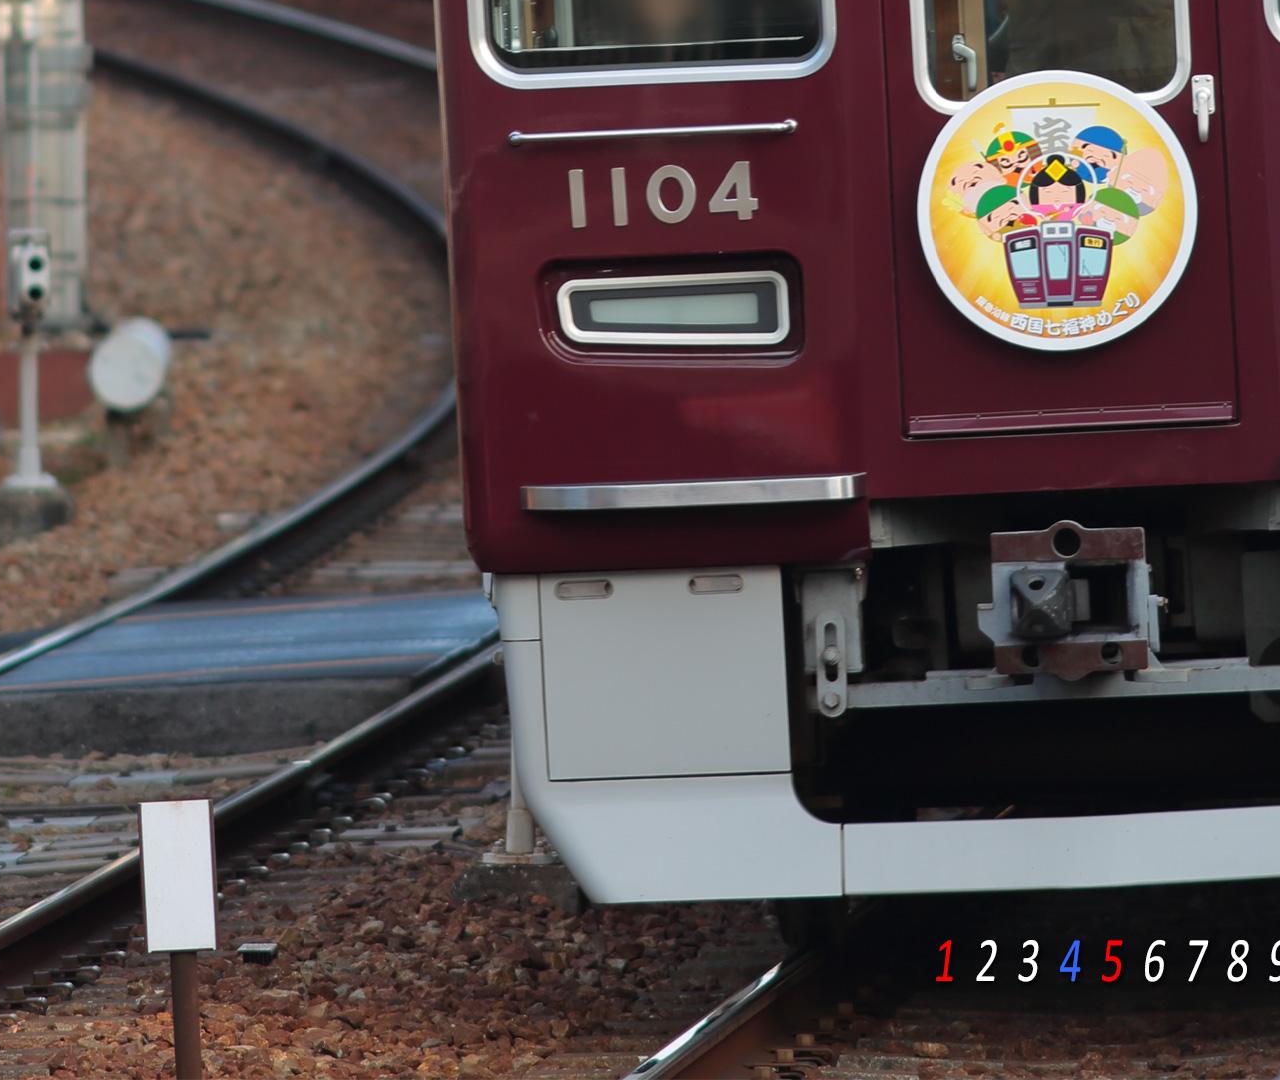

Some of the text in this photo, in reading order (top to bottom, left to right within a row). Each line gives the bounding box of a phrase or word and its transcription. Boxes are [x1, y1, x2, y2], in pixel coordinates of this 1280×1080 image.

[568, 161, 759, 228] 1104
[1011, 292, 1141, 336] 西国七福神めぐり
